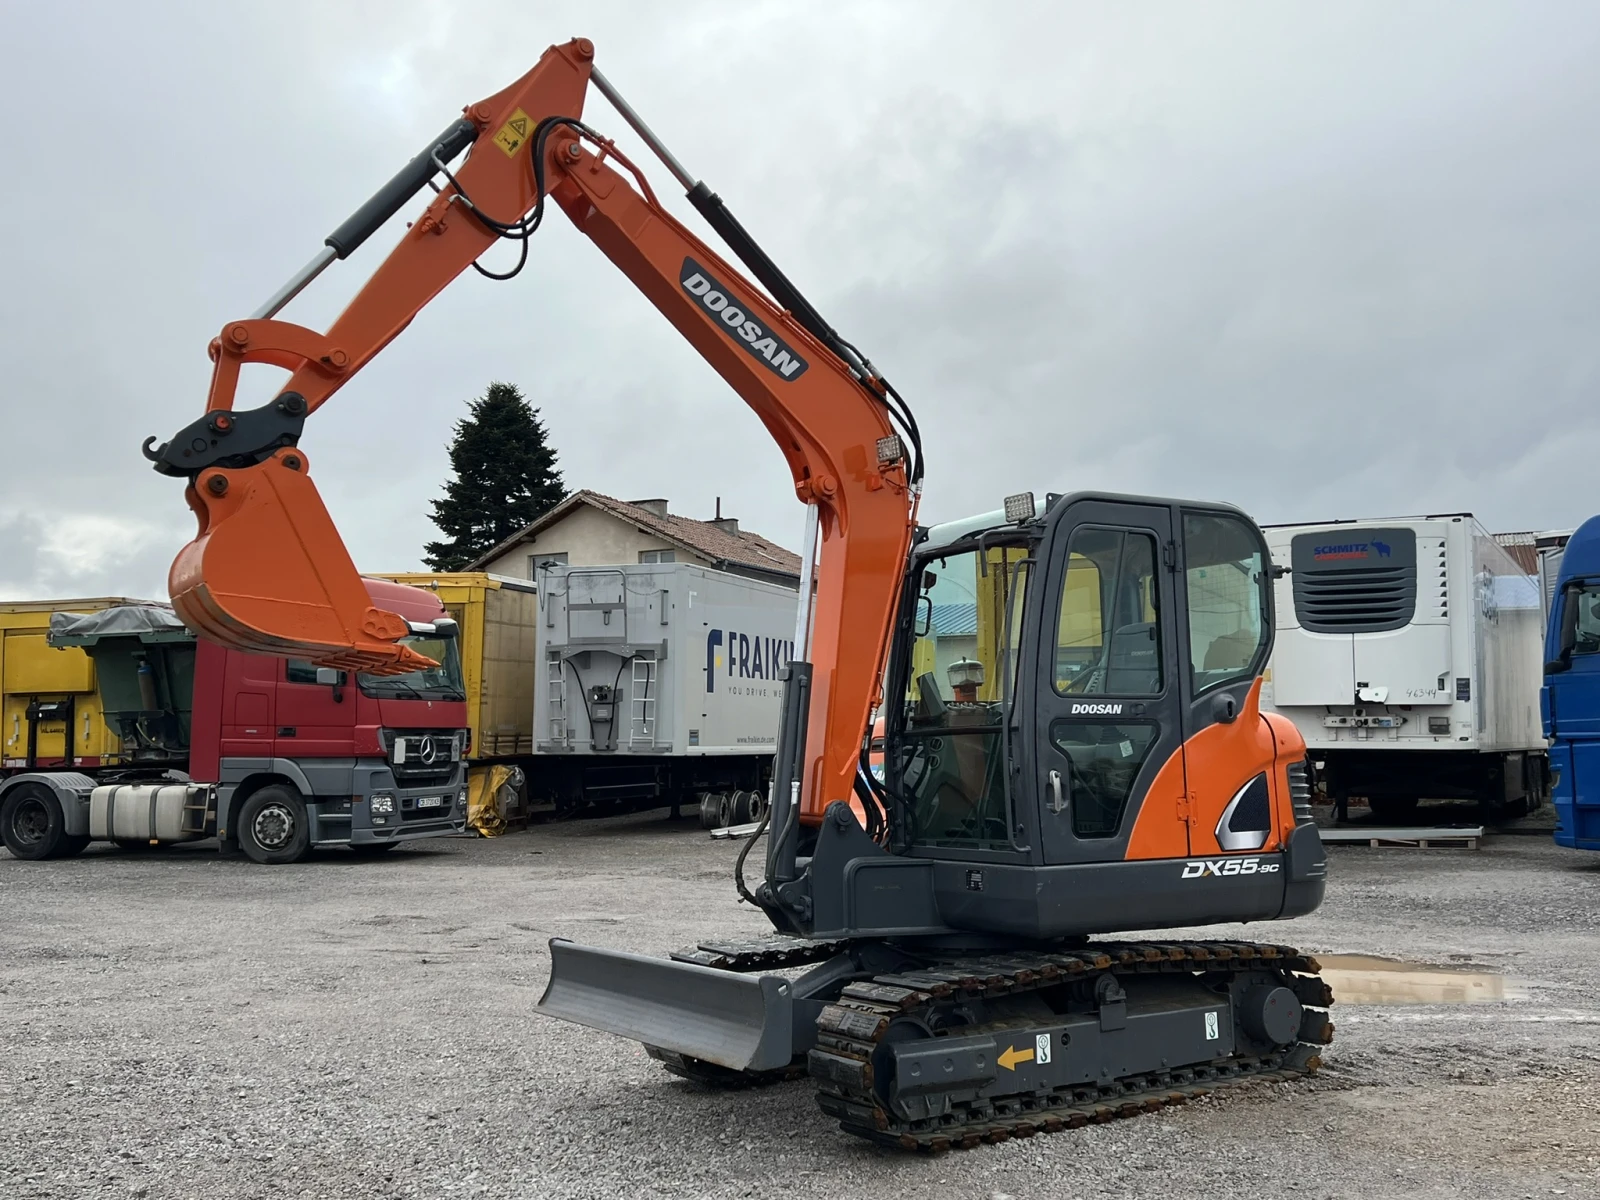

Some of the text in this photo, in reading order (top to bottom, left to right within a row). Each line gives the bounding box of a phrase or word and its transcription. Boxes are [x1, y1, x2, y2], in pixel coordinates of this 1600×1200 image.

[682, 272, 801, 377] DOOSAN
[1313, 543, 1368, 555] SCHMITZ
[728, 686, 742, 696] YOU
[1071, 703, 1123, 715] DOOSAN
